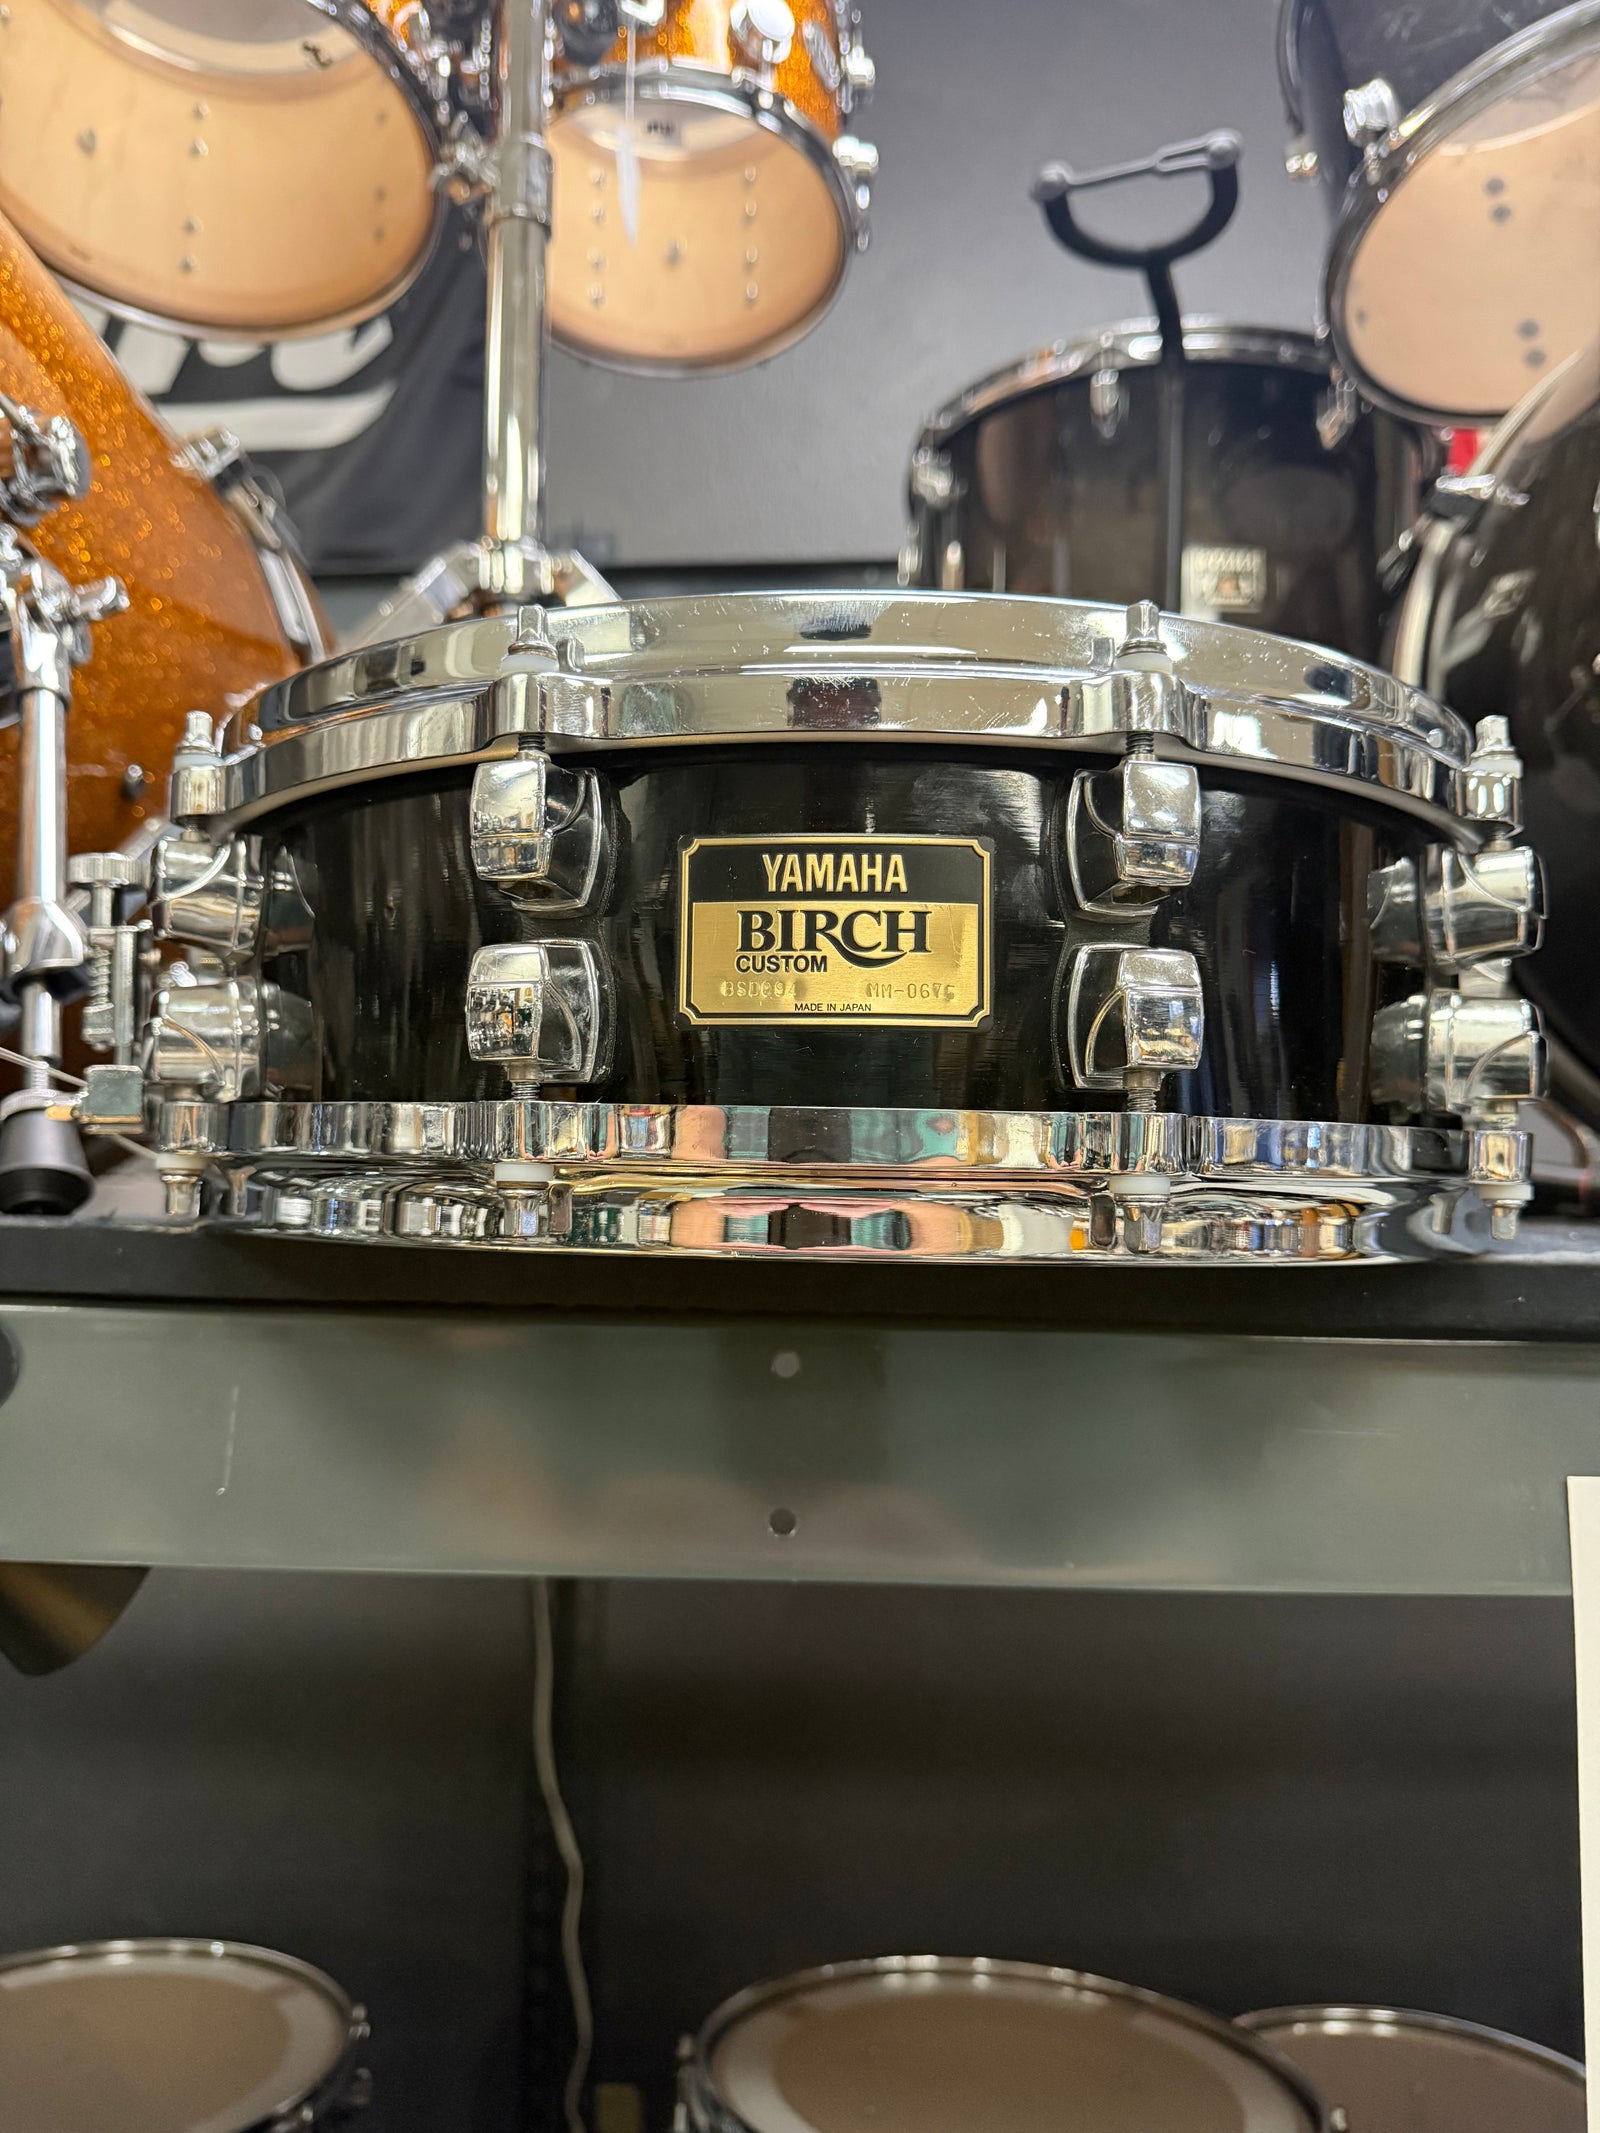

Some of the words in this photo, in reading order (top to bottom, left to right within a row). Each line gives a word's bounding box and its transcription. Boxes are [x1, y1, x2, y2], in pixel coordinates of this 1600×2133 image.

[762, 854, 908, 893] YAMAHA
[736, 910, 932, 968] BIRCH
[736, 955, 828, 973] CUSTOM
[794, 1003, 823, 1012] MADE
[826, 1003, 837, 1012] IN
[839, 1003, 872, 1012] JAPAN
